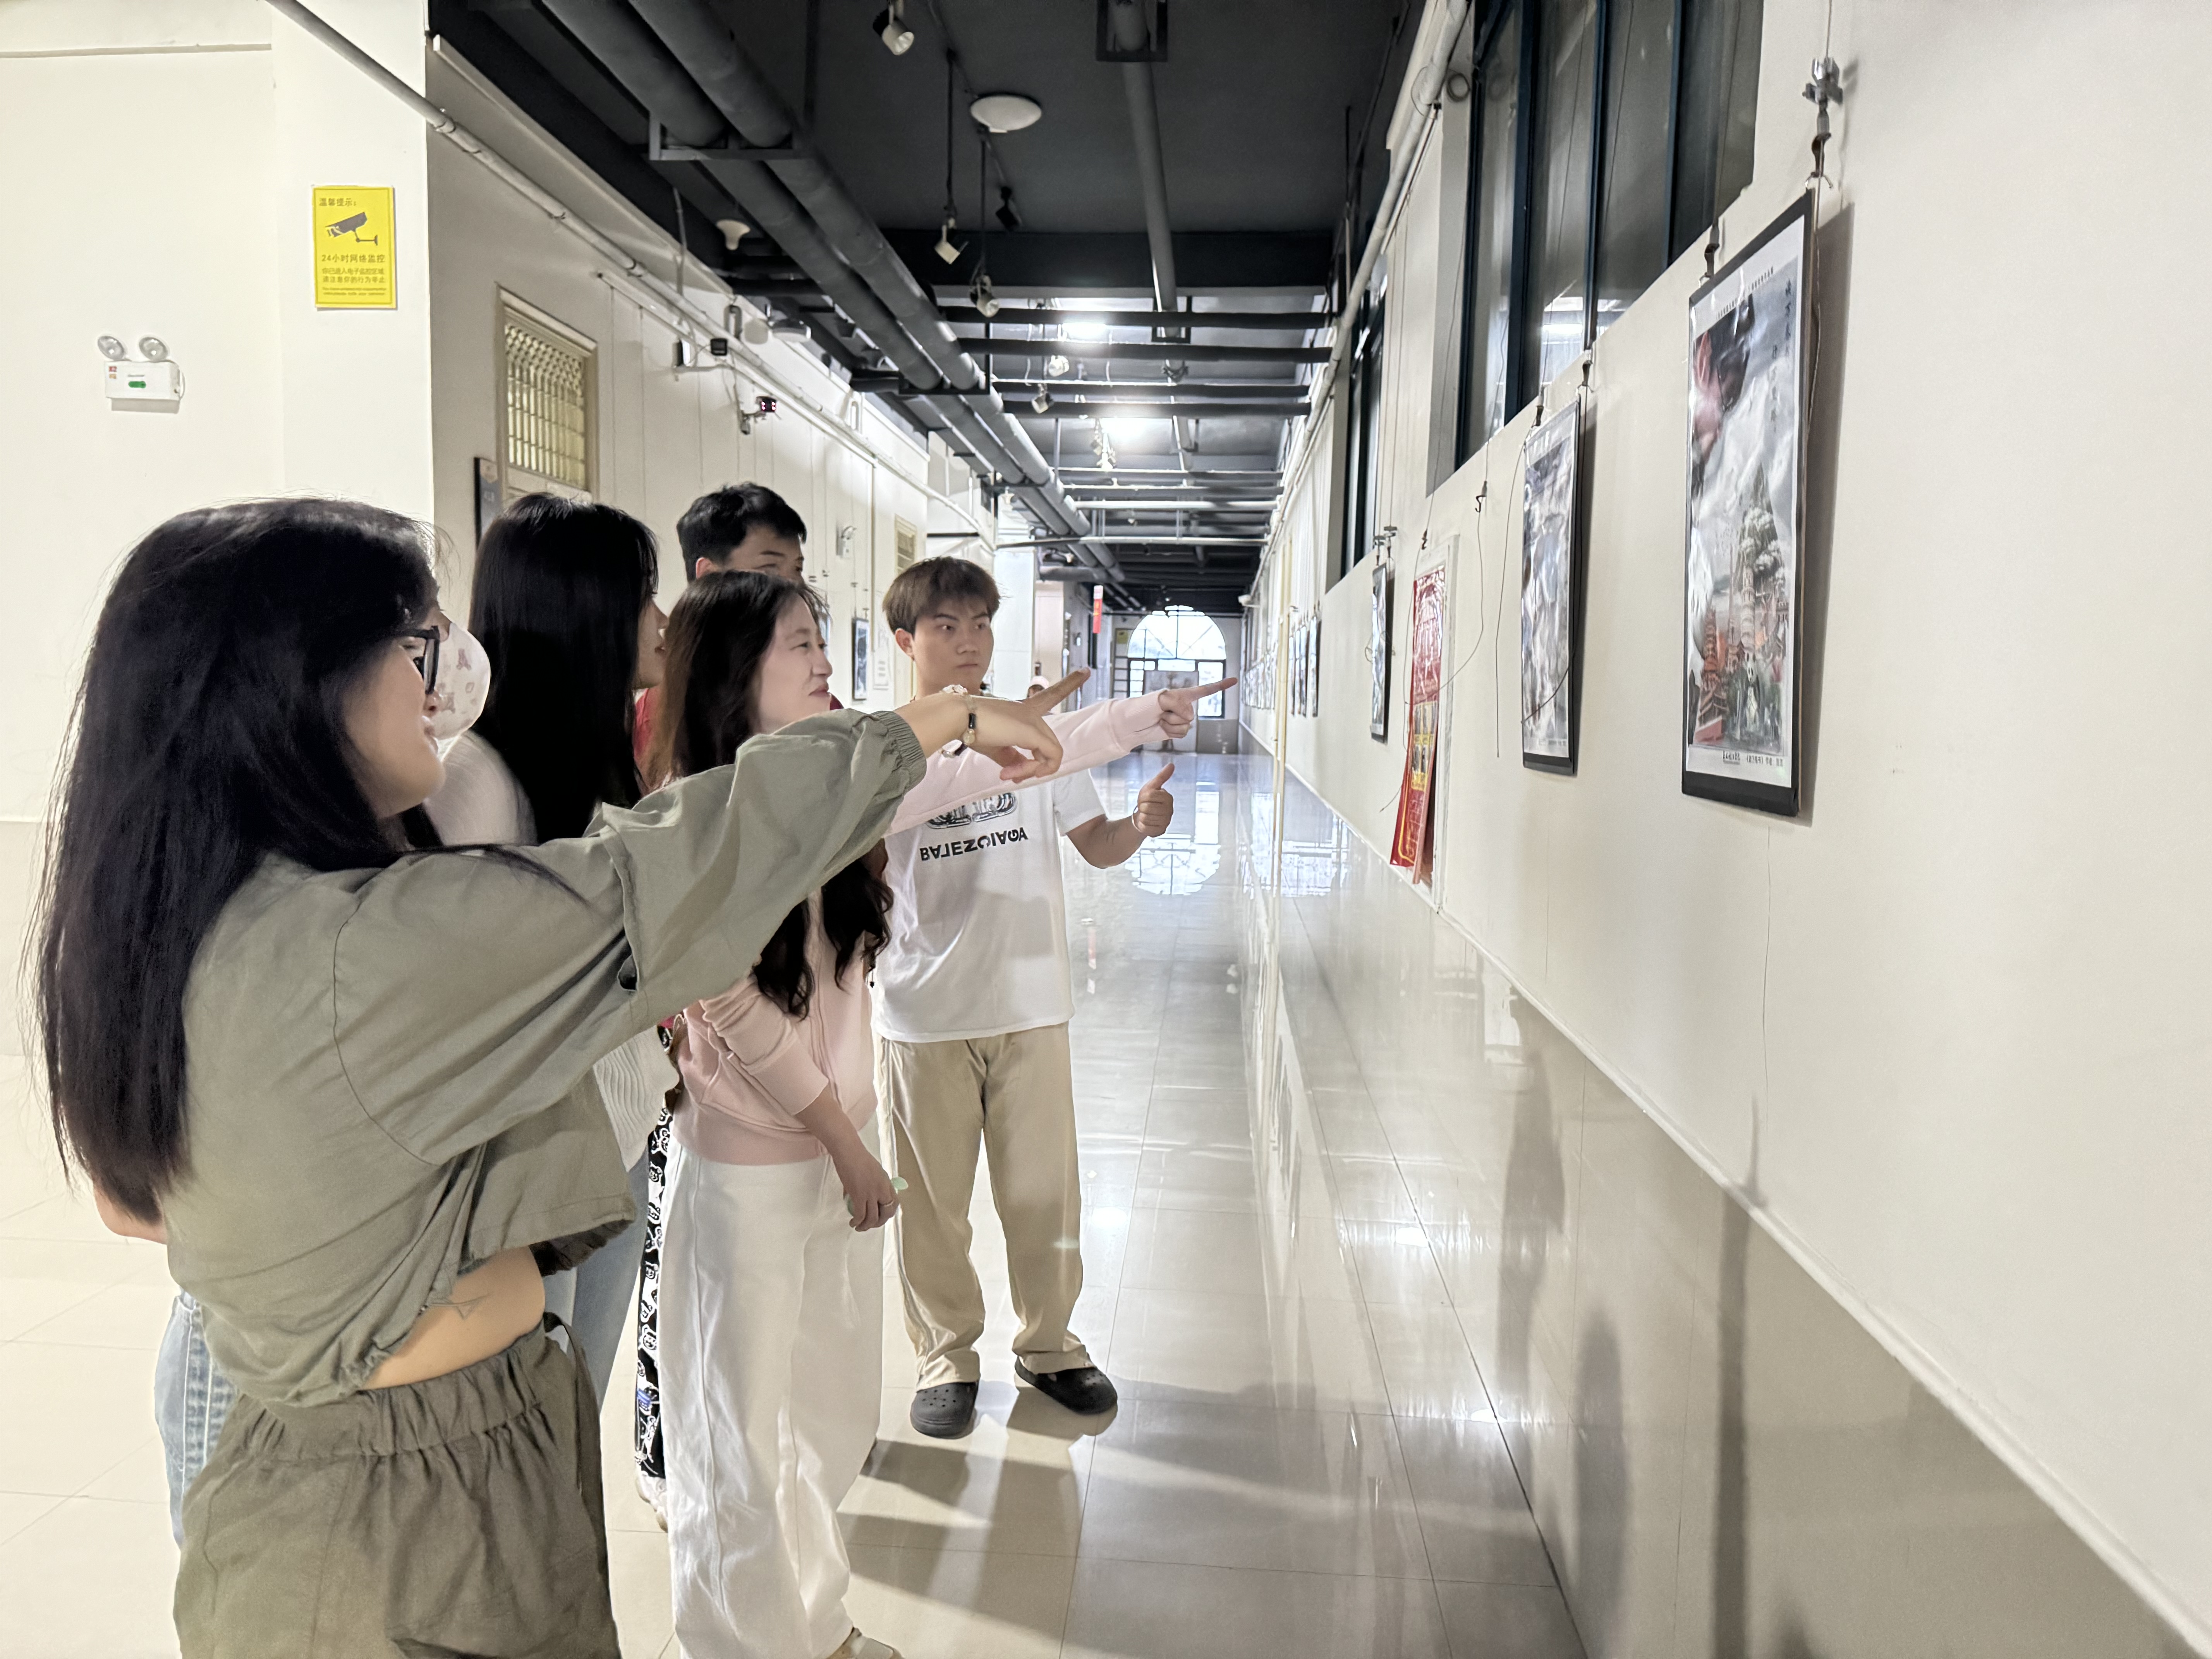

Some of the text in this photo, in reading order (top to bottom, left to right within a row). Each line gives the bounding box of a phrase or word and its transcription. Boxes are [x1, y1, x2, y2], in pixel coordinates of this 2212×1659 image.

[322, 254, 385, 263] 24小时网络监控
